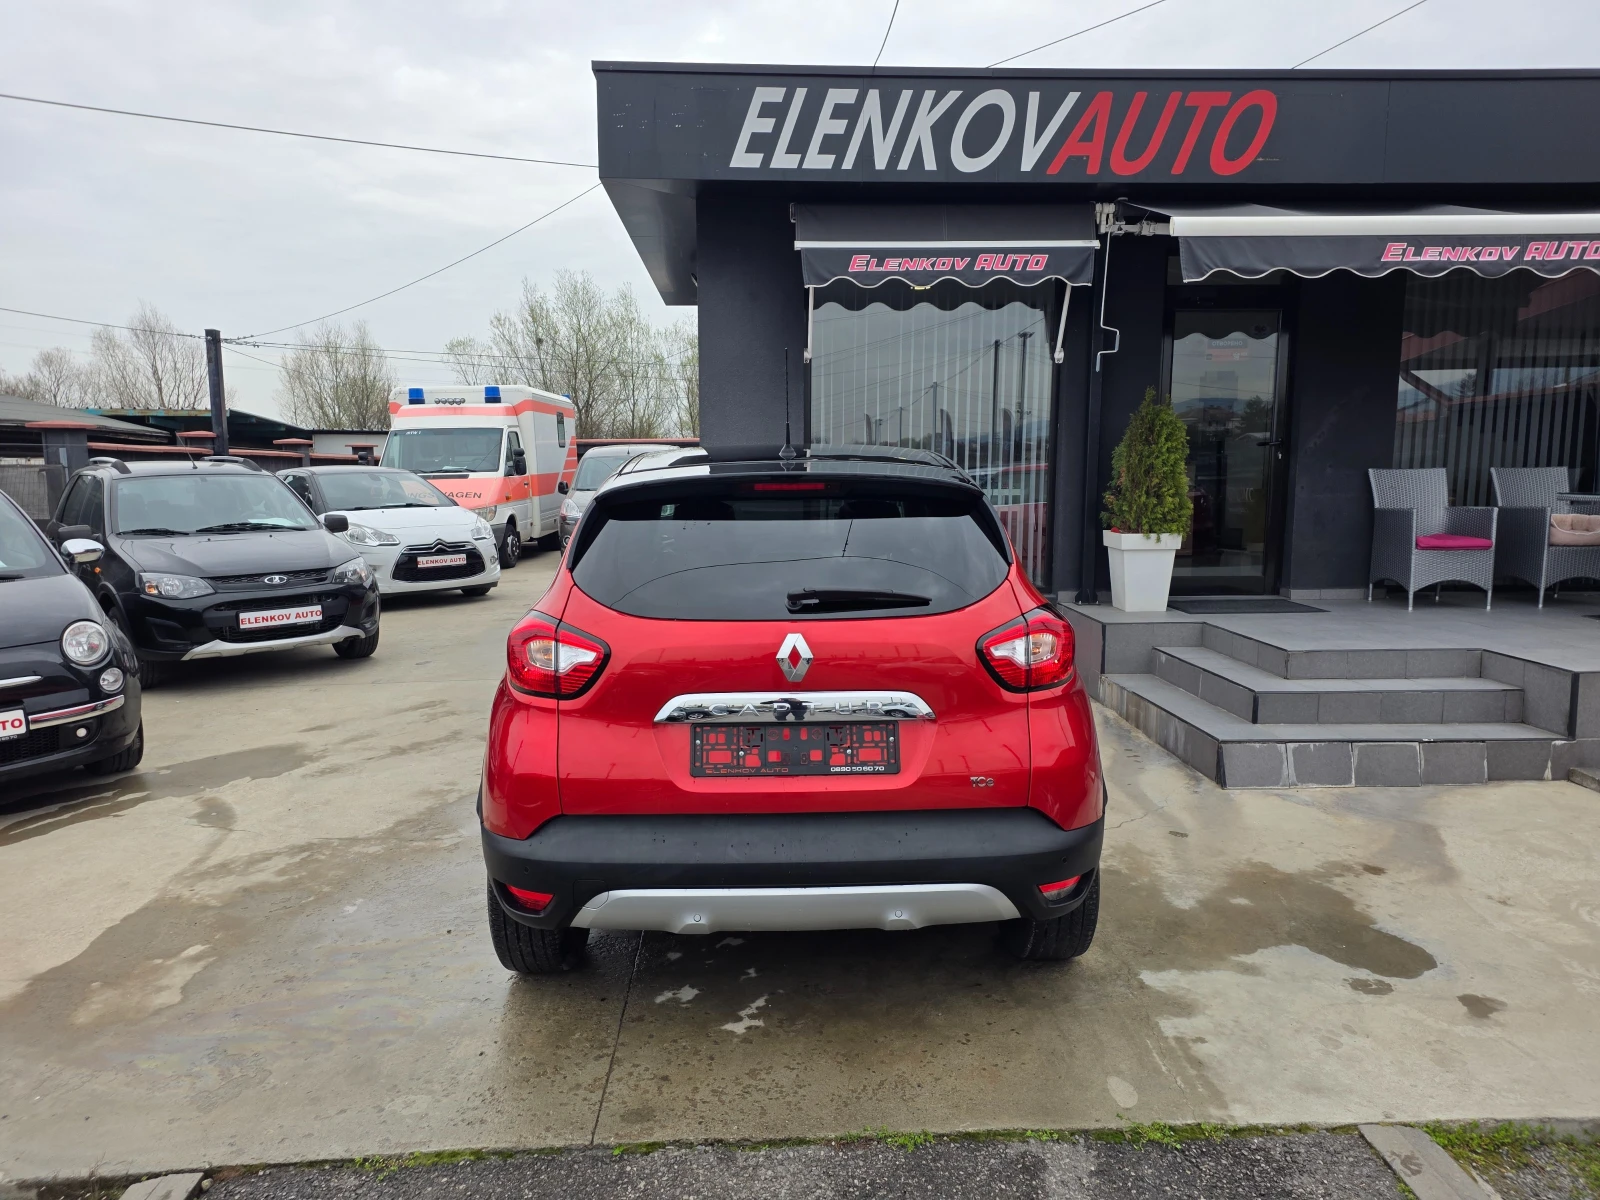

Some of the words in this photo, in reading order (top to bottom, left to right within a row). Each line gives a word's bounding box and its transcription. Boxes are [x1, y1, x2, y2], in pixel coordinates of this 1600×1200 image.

[1381, 242, 1521, 262] ELENKOV
[1524, 240, 1600, 261] AUTO
[848, 254, 971, 272] ELENKOV
[974, 253, 1050, 271] AUTO
[416, 558, 448, 566] ELENKOV
[240, 613, 292, 626] ELENKOV
[294, 609, 323, 620] AUTO
[708, 701, 886, 717] CAPTUR
[969, 776, 994, 788] TCe
